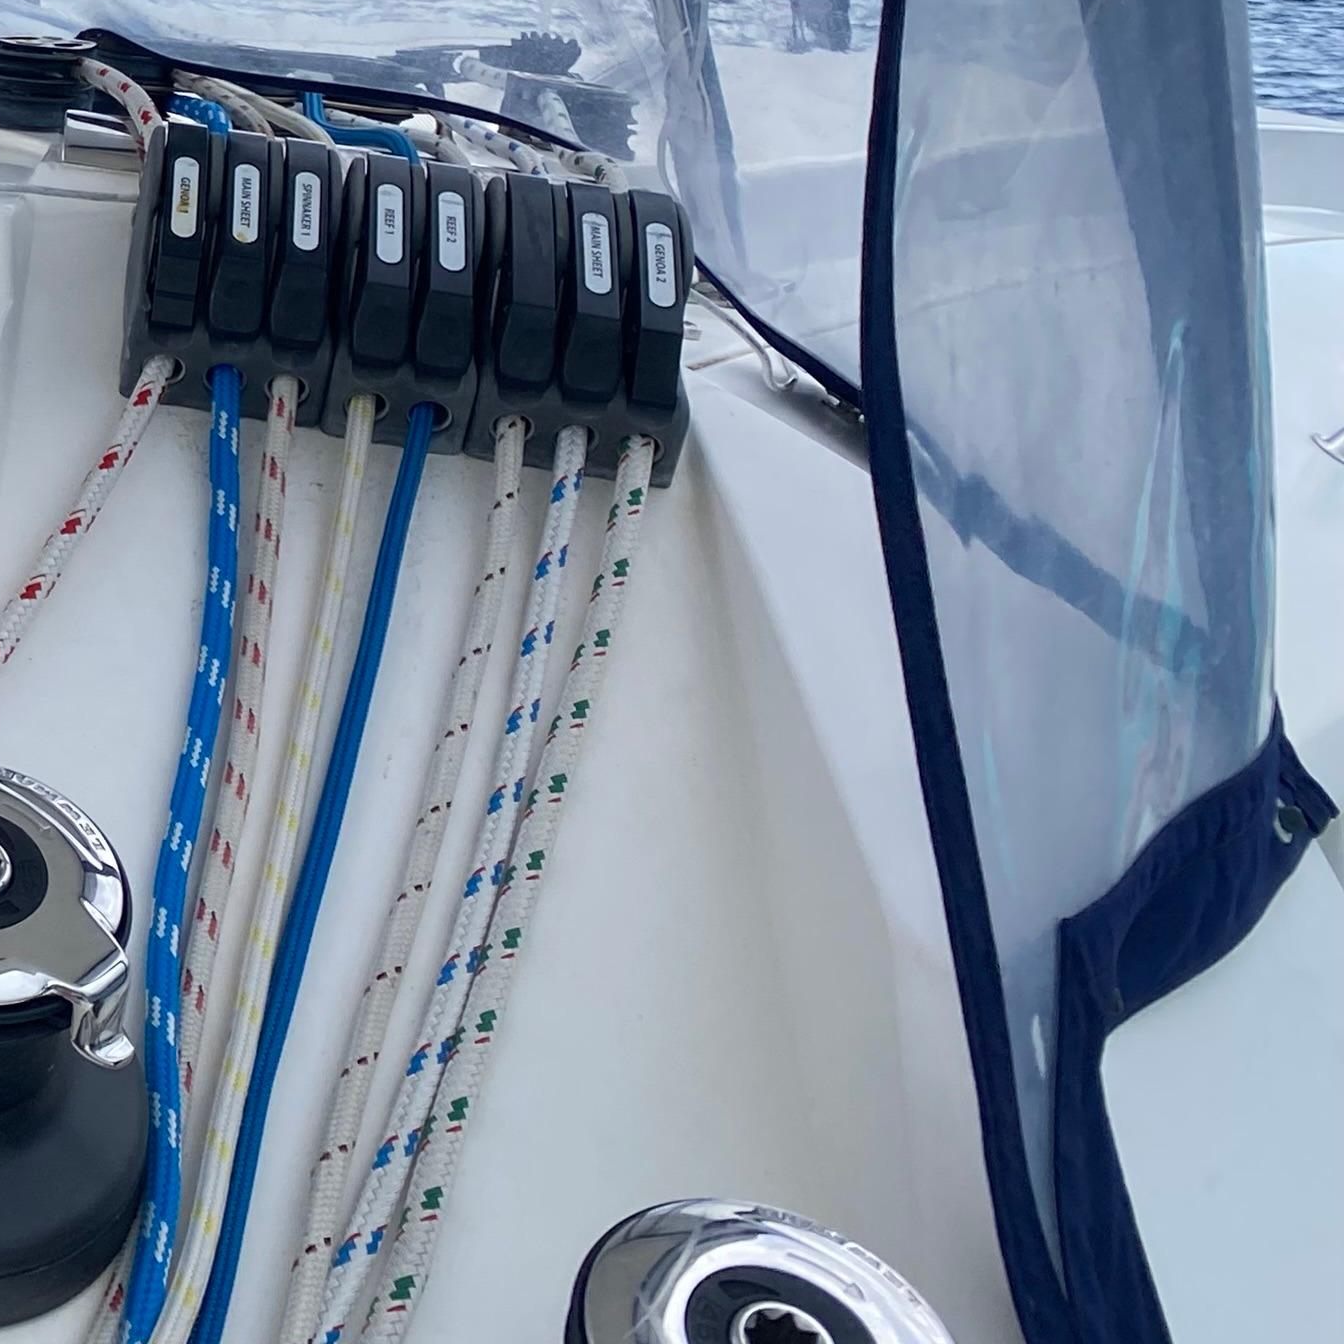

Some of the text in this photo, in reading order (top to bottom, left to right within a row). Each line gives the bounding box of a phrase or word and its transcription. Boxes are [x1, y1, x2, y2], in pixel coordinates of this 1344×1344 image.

[240, 177, 252, 228] MAIN SHEET
[301, 183, 313, 231] SPINNAKER
[384, 208, 395, 229] REEF
[446, 215, 457, 236] REEF
[590, 222, 604, 278] MAIN SHEET
[654, 243, 666, 276] GENOA
